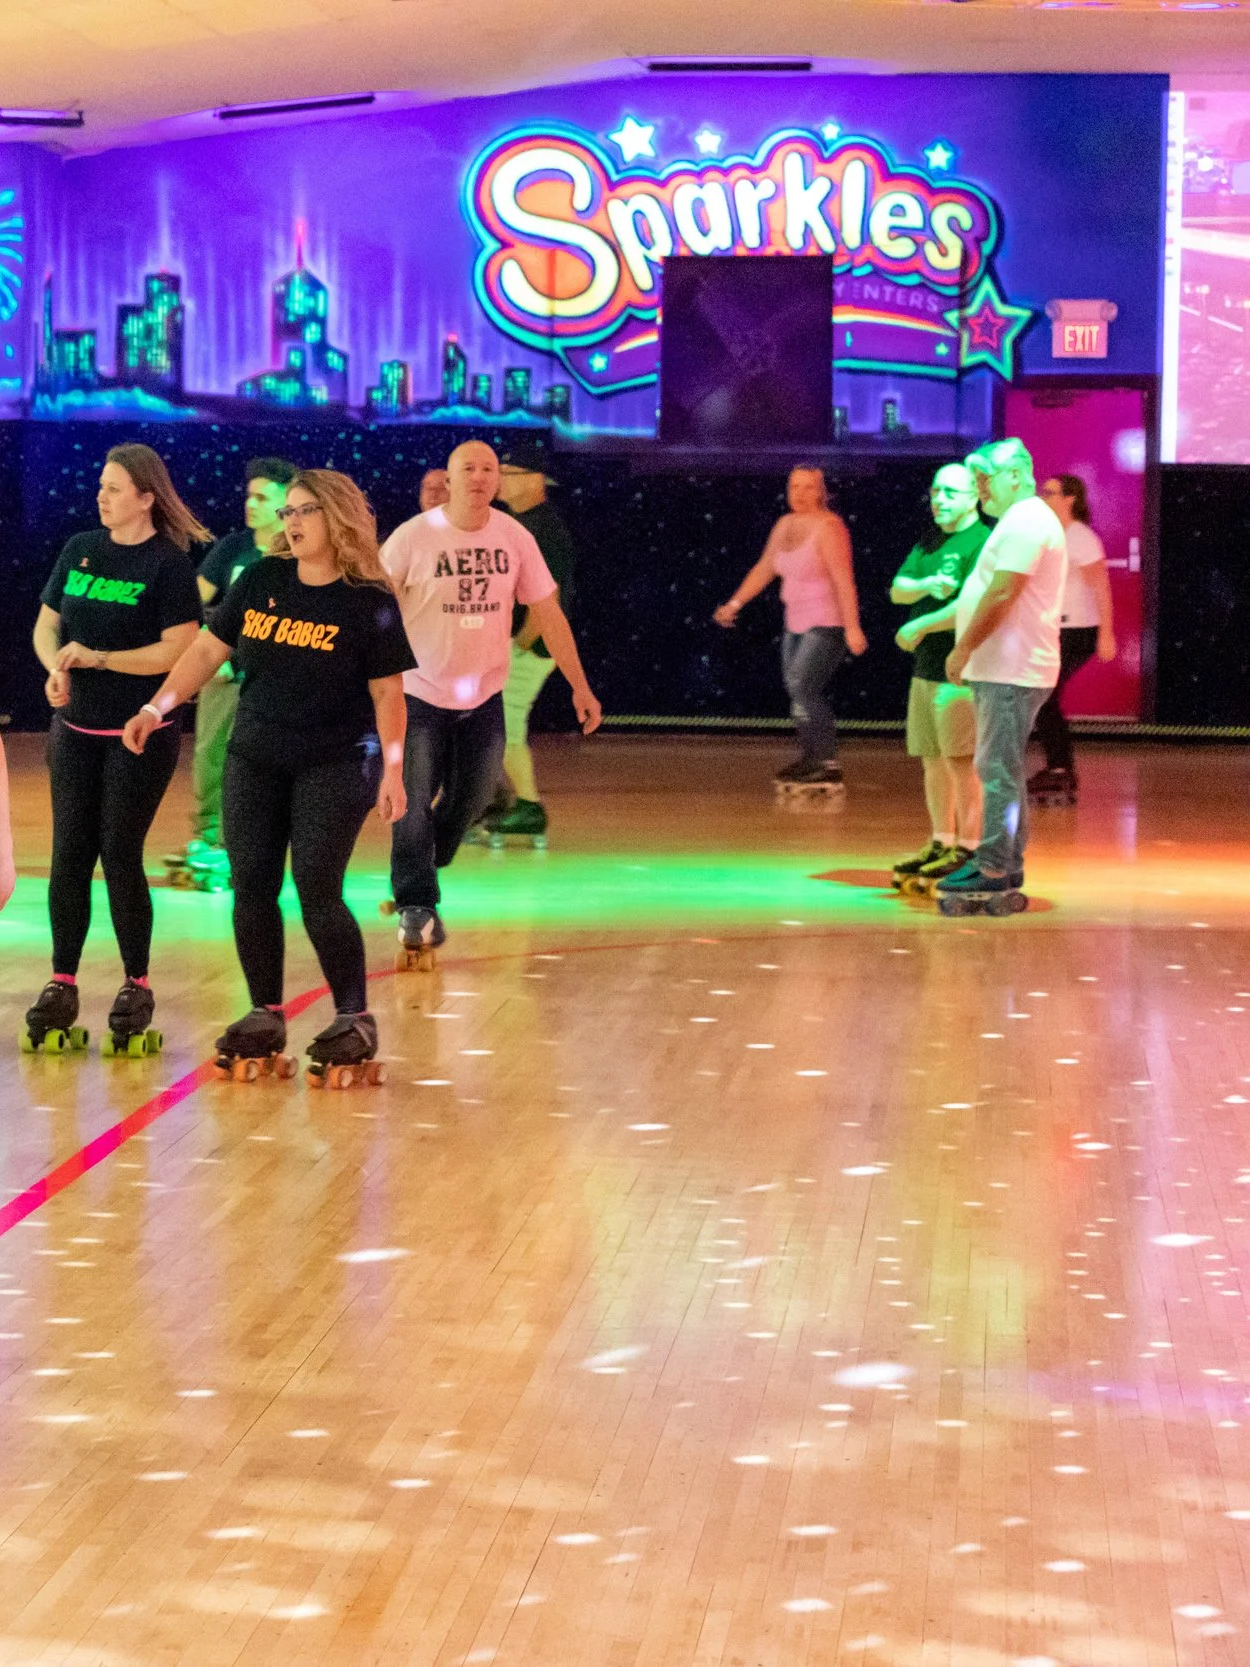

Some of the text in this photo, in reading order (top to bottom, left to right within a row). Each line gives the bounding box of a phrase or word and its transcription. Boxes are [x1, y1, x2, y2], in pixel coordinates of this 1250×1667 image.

[491, 147, 973, 318] Sparkles
[1064, 325, 1100, 352] EXIT
[434, 548, 509, 577] AERO
[459, 577, 490, 602] 87
[242, 608, 278, 640] SK8
